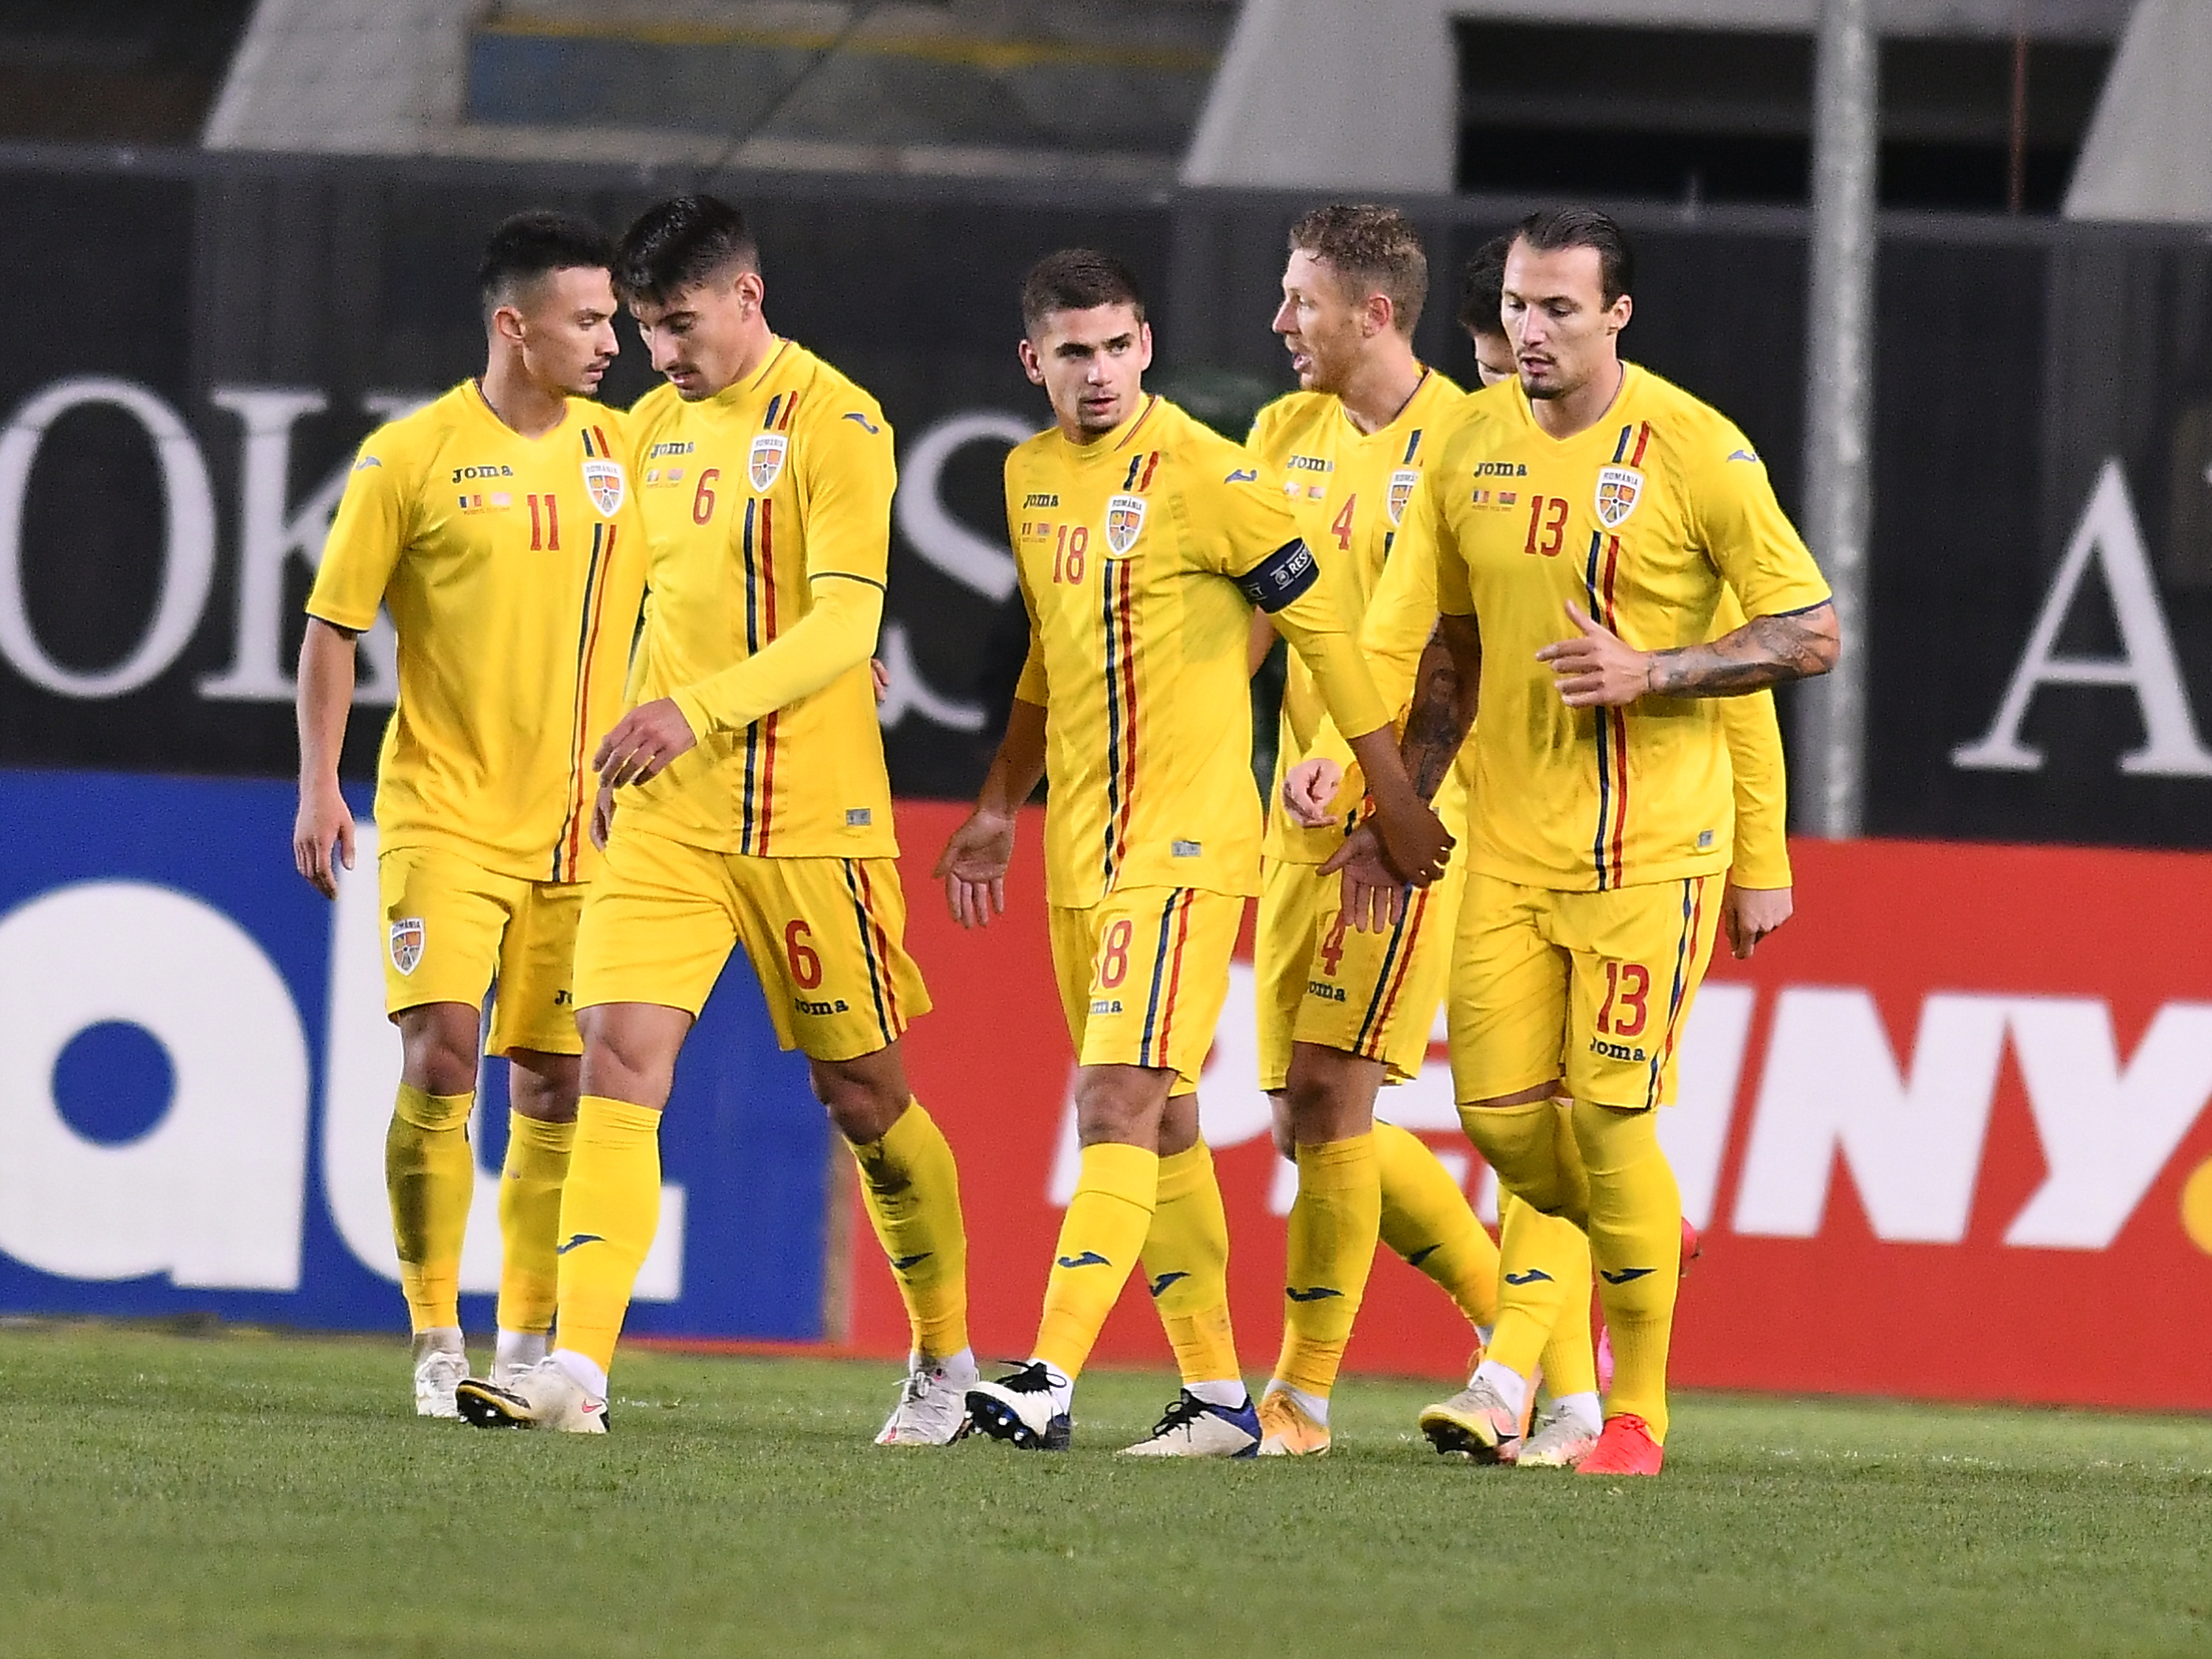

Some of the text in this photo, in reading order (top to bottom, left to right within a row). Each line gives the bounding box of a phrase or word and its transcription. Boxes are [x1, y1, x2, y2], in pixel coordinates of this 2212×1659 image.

[451, 465, 514, 484] Joma
[650, 441, 695, 459] Joma
[1473, 462, 1527, 478] Joma
[526, 493, 560, 552] 11
[692, 467, 721, 526] 6
[1022, 493, 1060, 509] Joma
[1331, 493, 1357, 552] 4
[1523, 494, 1570, 558] 13
[1053, 524, 1090, 585] 18
[1950, 456, 2212, 778] A
[785, 919, 823, 990] 6
[1091, 919, 1133, 992] 8
[1320, 910, 1348, 977] 4
[1309, 981, 1346, 1002] oma
[1596, 962, 1650, 1037] 13
